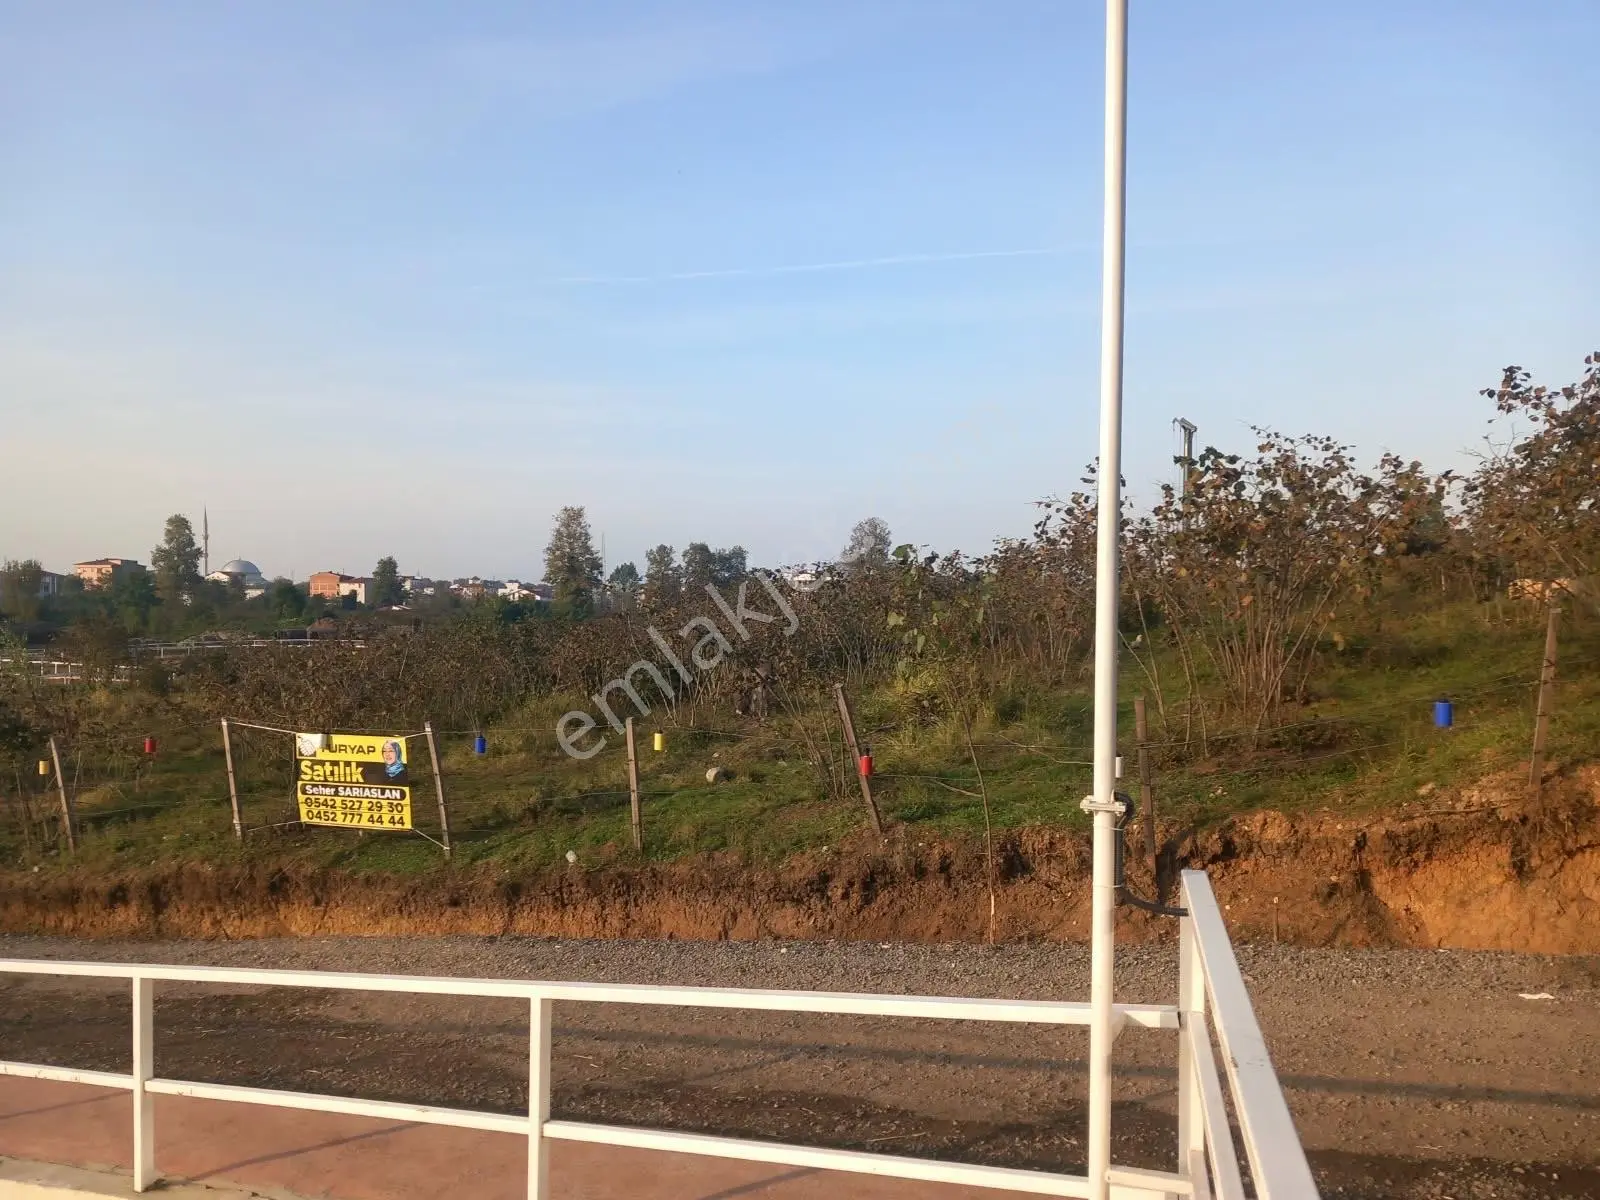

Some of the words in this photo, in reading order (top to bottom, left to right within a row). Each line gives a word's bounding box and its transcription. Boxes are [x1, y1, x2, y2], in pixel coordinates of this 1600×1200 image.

[300, 760, 364, 782] Satılık
[305, 785, 335, 795] Seher
[338, 787, 401, 799] SARIASLAN
[305, 797, 337, 808] 0542
[341, 800, 362, 810] 527
[368, 801, 382, 812] 29
[387, 802, 404, 813] 30
[306, 810, 338, 822] 0452
[342, 812, 362, 824] 777
[368, 814, 384, 825] 44
[388, 816, 405, 826] 44
